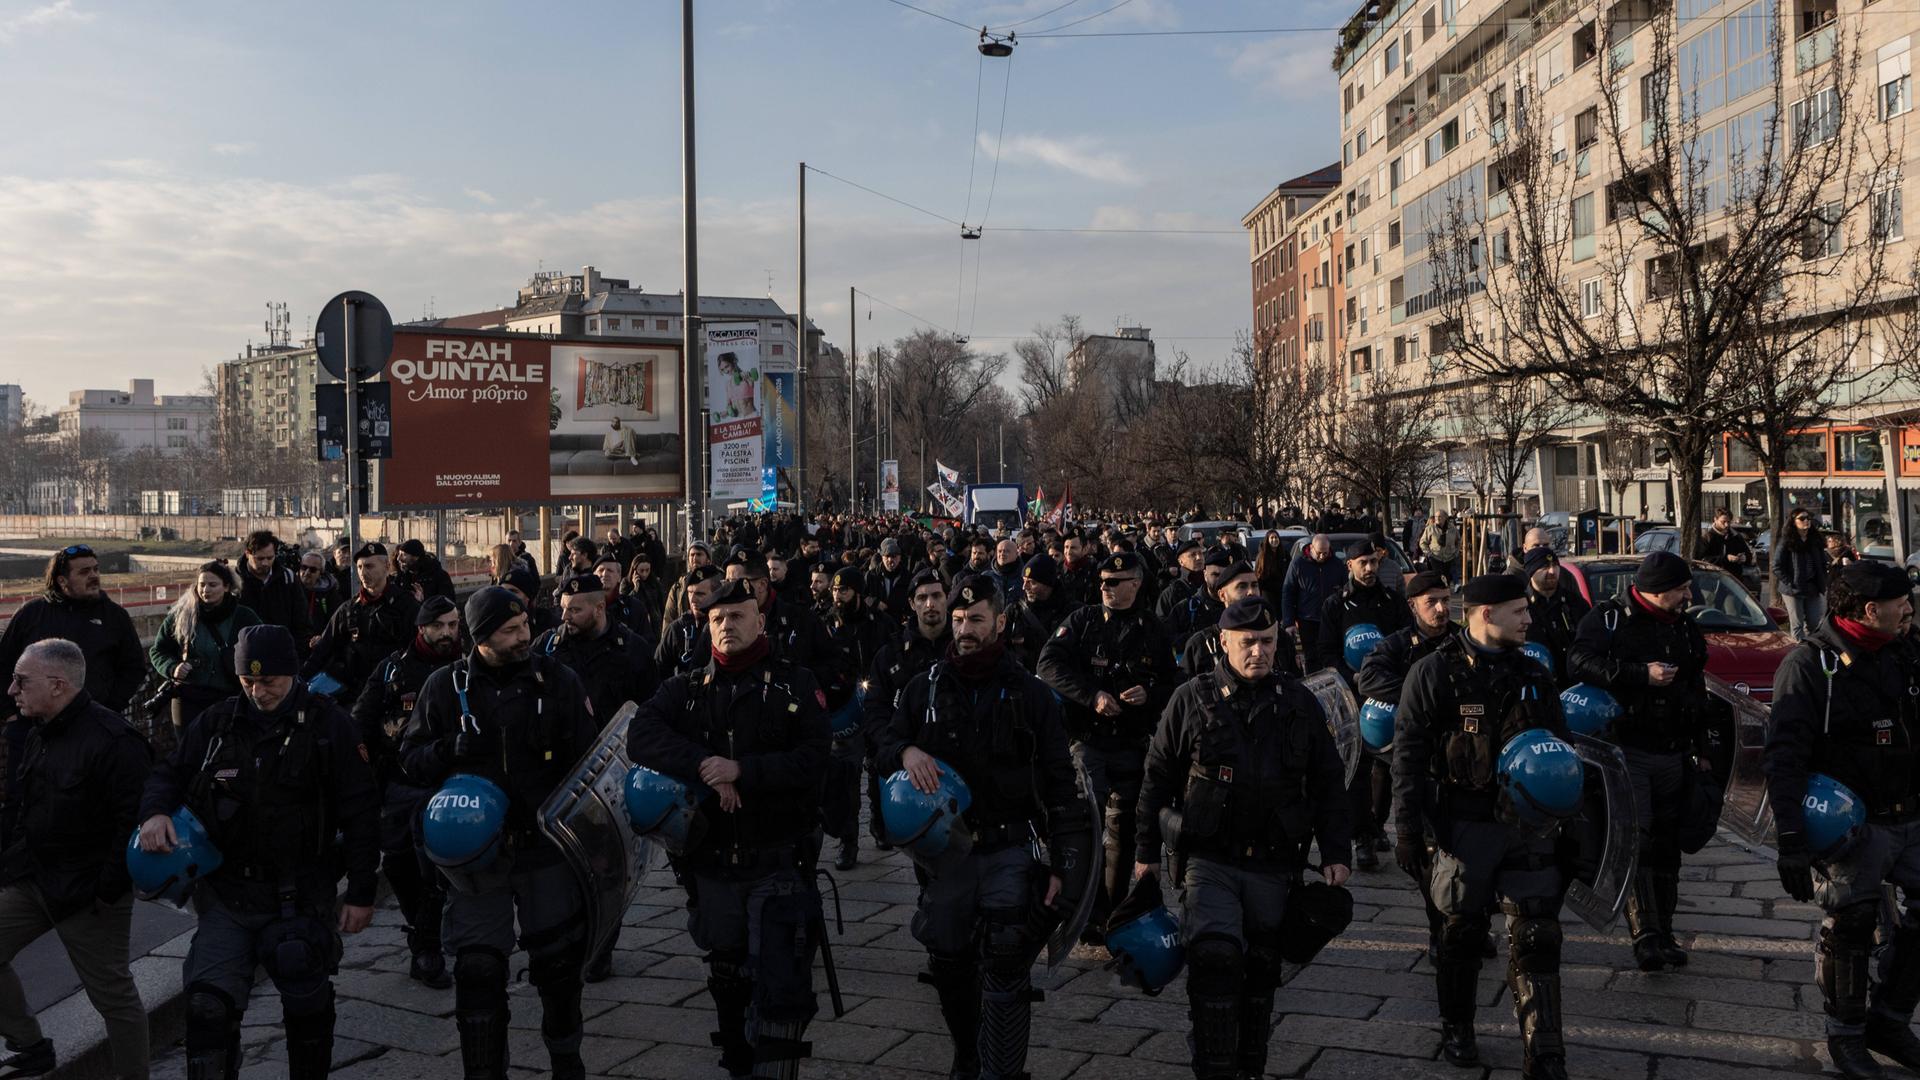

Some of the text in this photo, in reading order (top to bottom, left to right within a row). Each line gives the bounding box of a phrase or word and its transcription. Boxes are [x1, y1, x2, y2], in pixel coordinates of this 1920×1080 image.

[426, 339, 512, 362] FRAH
[390, 359, 544, 385] QUINTALE
[408, 382, 528, 404] Amor proprio
[743, 421, 758, 429] VITA
[722, 429, 751, 440] CAMBIA!
[775, 428, 783, 461] MILANO
[721, 450, 752, 458] PALESTRA
[1586, 519, 1595, 533] P
